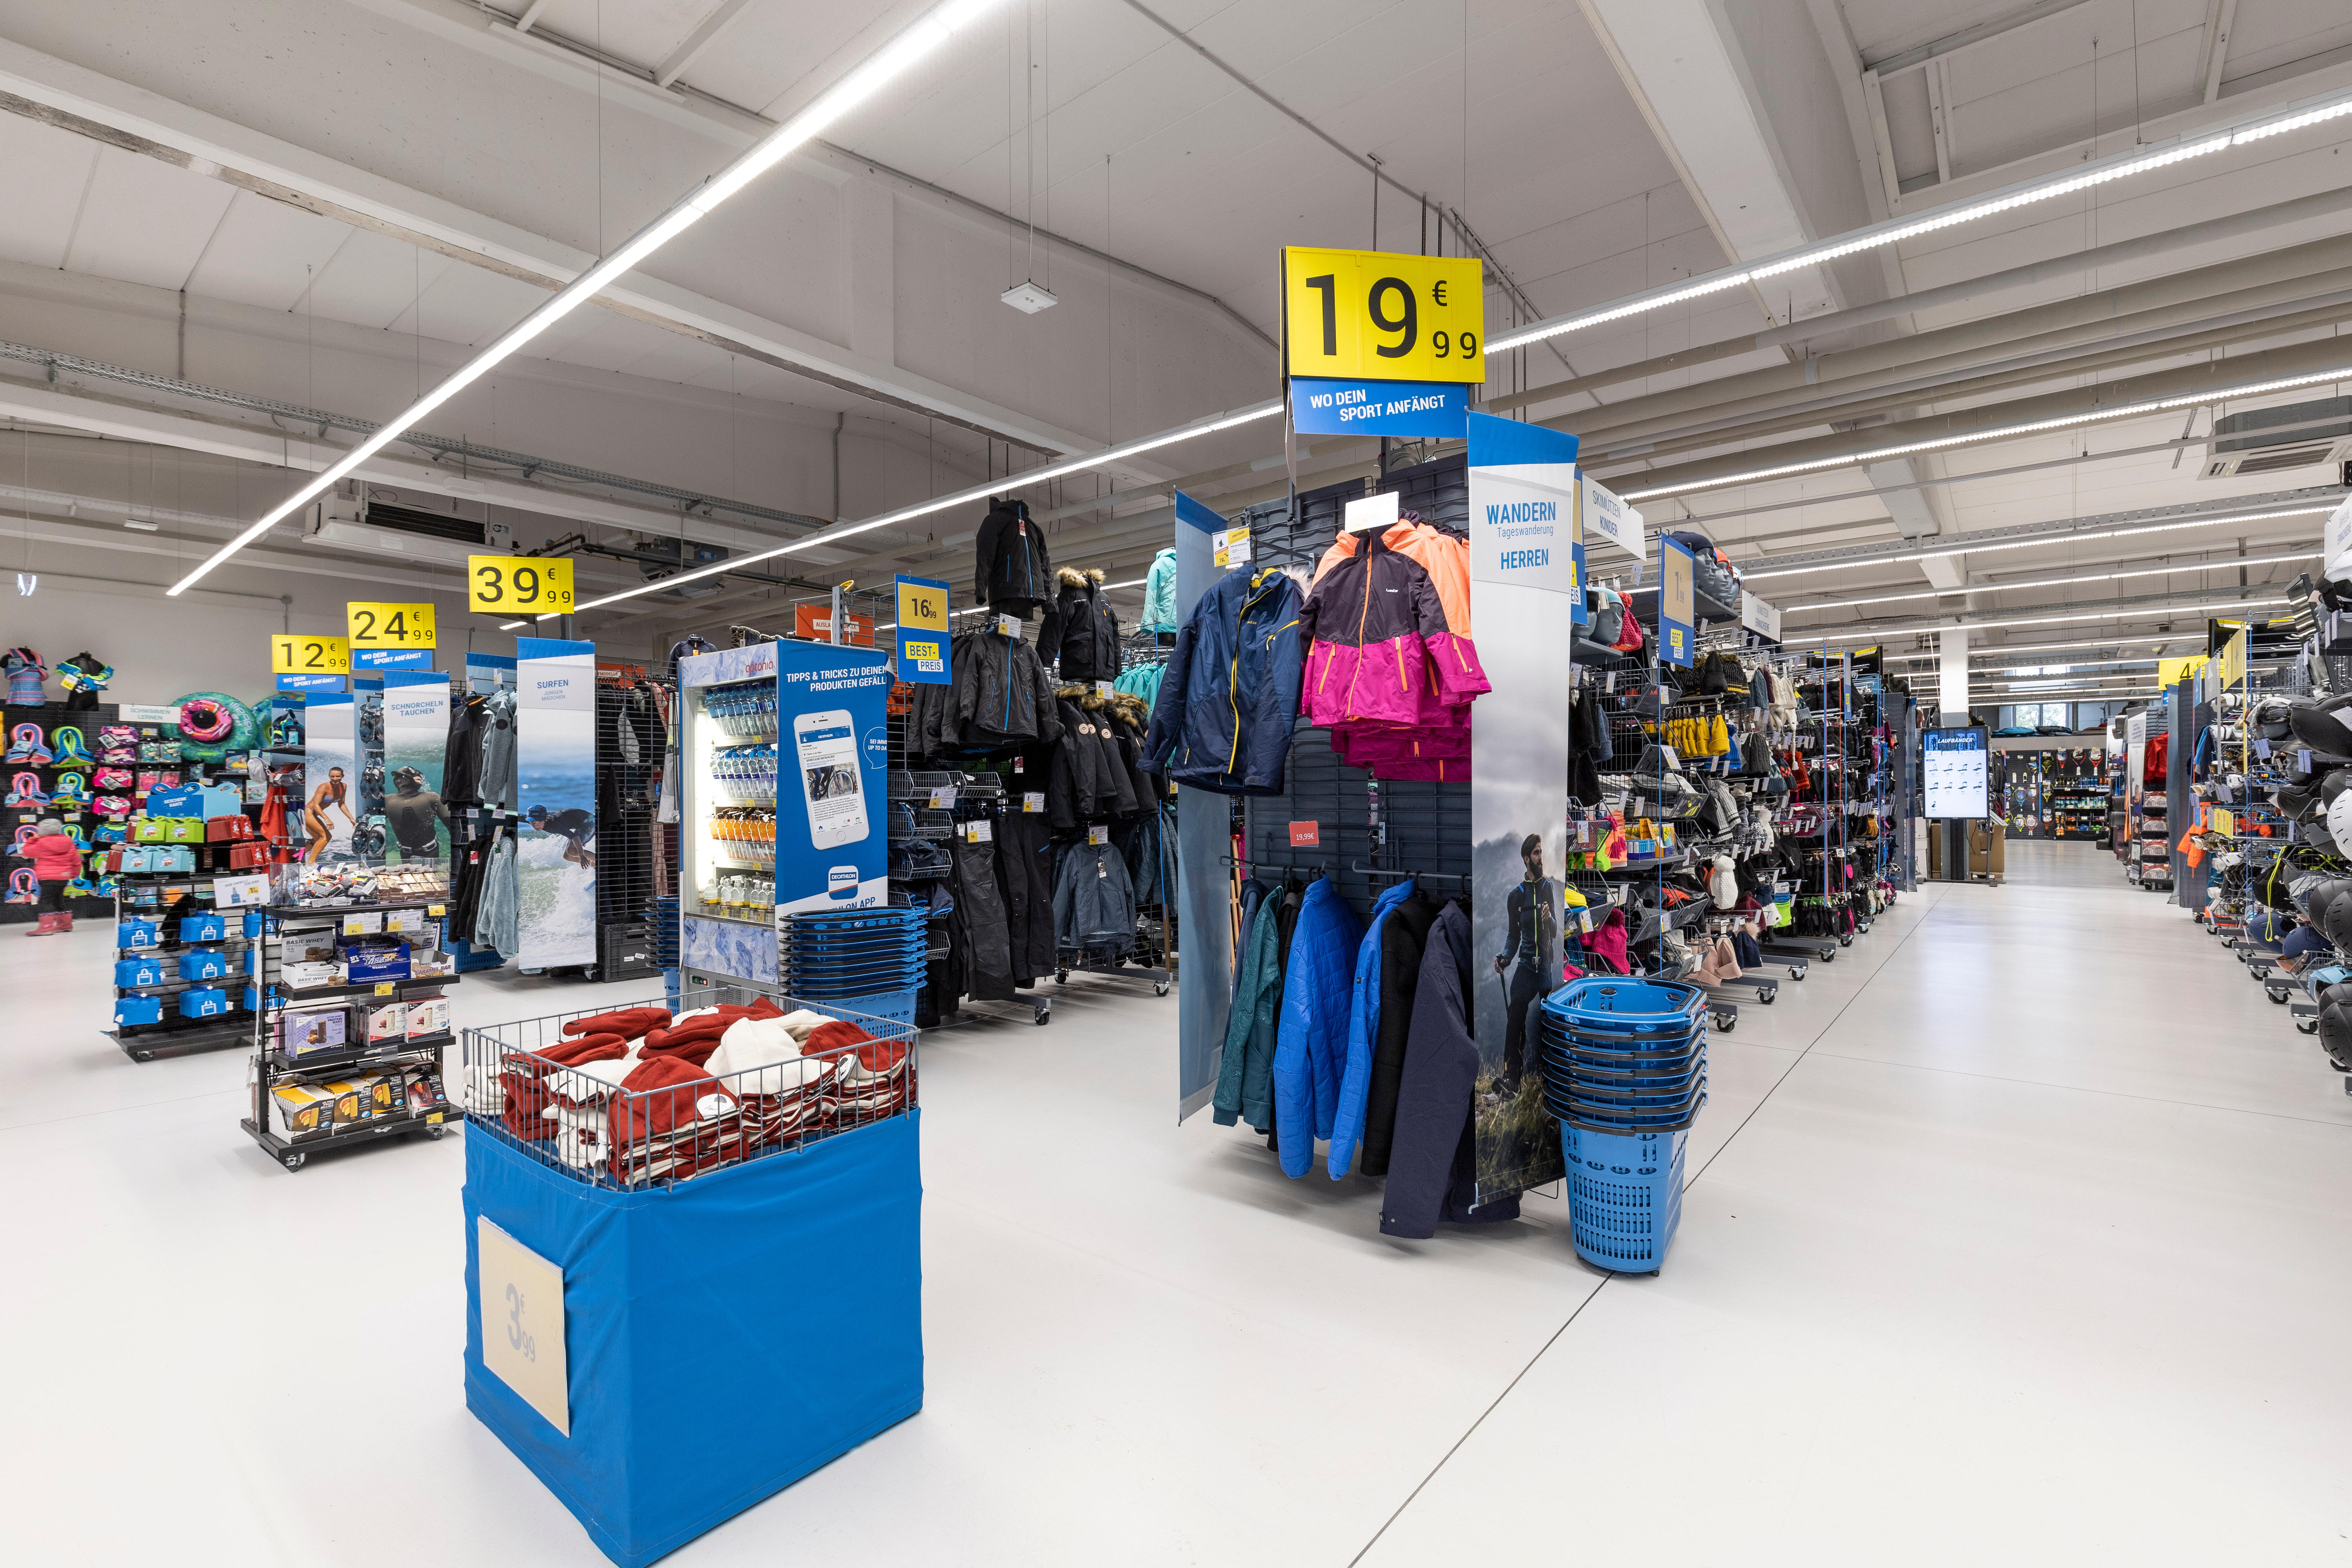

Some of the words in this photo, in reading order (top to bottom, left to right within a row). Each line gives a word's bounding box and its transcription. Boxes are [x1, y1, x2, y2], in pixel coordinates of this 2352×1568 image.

[1432, 280, 1447, 306] €
[1306, 274, 1417, 358] 19
[1433, 331, 1476, 359] 99
[1310, 394, 1332, 408] WO
[1336, 389, 1366, 405] DEIN
[1340, 403, 1382, 421] SPORT
[1386, 395, 1445, 415] ANFÄNGT
[1593, 490, 1621, 519] SKIMÜTZEN
[1486, 502, 1556, 525] WANDERN
[1497, 524, 1553, 539] Tageswanderung
[1600, 515, 1618, 538] KINDER
[1501, 548, 1548, 570] HERREN
[547, 568, 556, 580] €
[477, 567, 539, 603] 39
[1675, 572, 1678, 601] 1
[548, 591, 570, 603] 99
[912, 598, 929, 617] 16
[413, 612, 420, 621] €
[354, 611, 408, 640] 24
[413, 630, 433, 640] 99
[1672, 632, 1681, 645] BEST-
[281, 643, 324, 667] 12
[394, 652, 422, 662] ANFÄNGT
[910, 645, 936, 657] BEST-
[745, 661, 773, 674] aptonia
[921, 662, 940, 670] PREIS
[2180, 663, 2191, 678] 4
[787, 672, 810, 682] TIPPS
[812, 672, 818, 680] &
[820, 669, 848, 679] TRICKS
[850, 668, 859, 677] ZU
[537, 679, 569, 689] SURFEN
[810, 679, 857, 692] PRODUKTEN
[391, 701, 443, 710] SCHNORCHELN
[400, 708, 434, 716] TAUCHEN
[860, 897, 875, 908] APP
[506, 1283, 521, 1350] 3
[522, 1331, 536, 1363] 99
